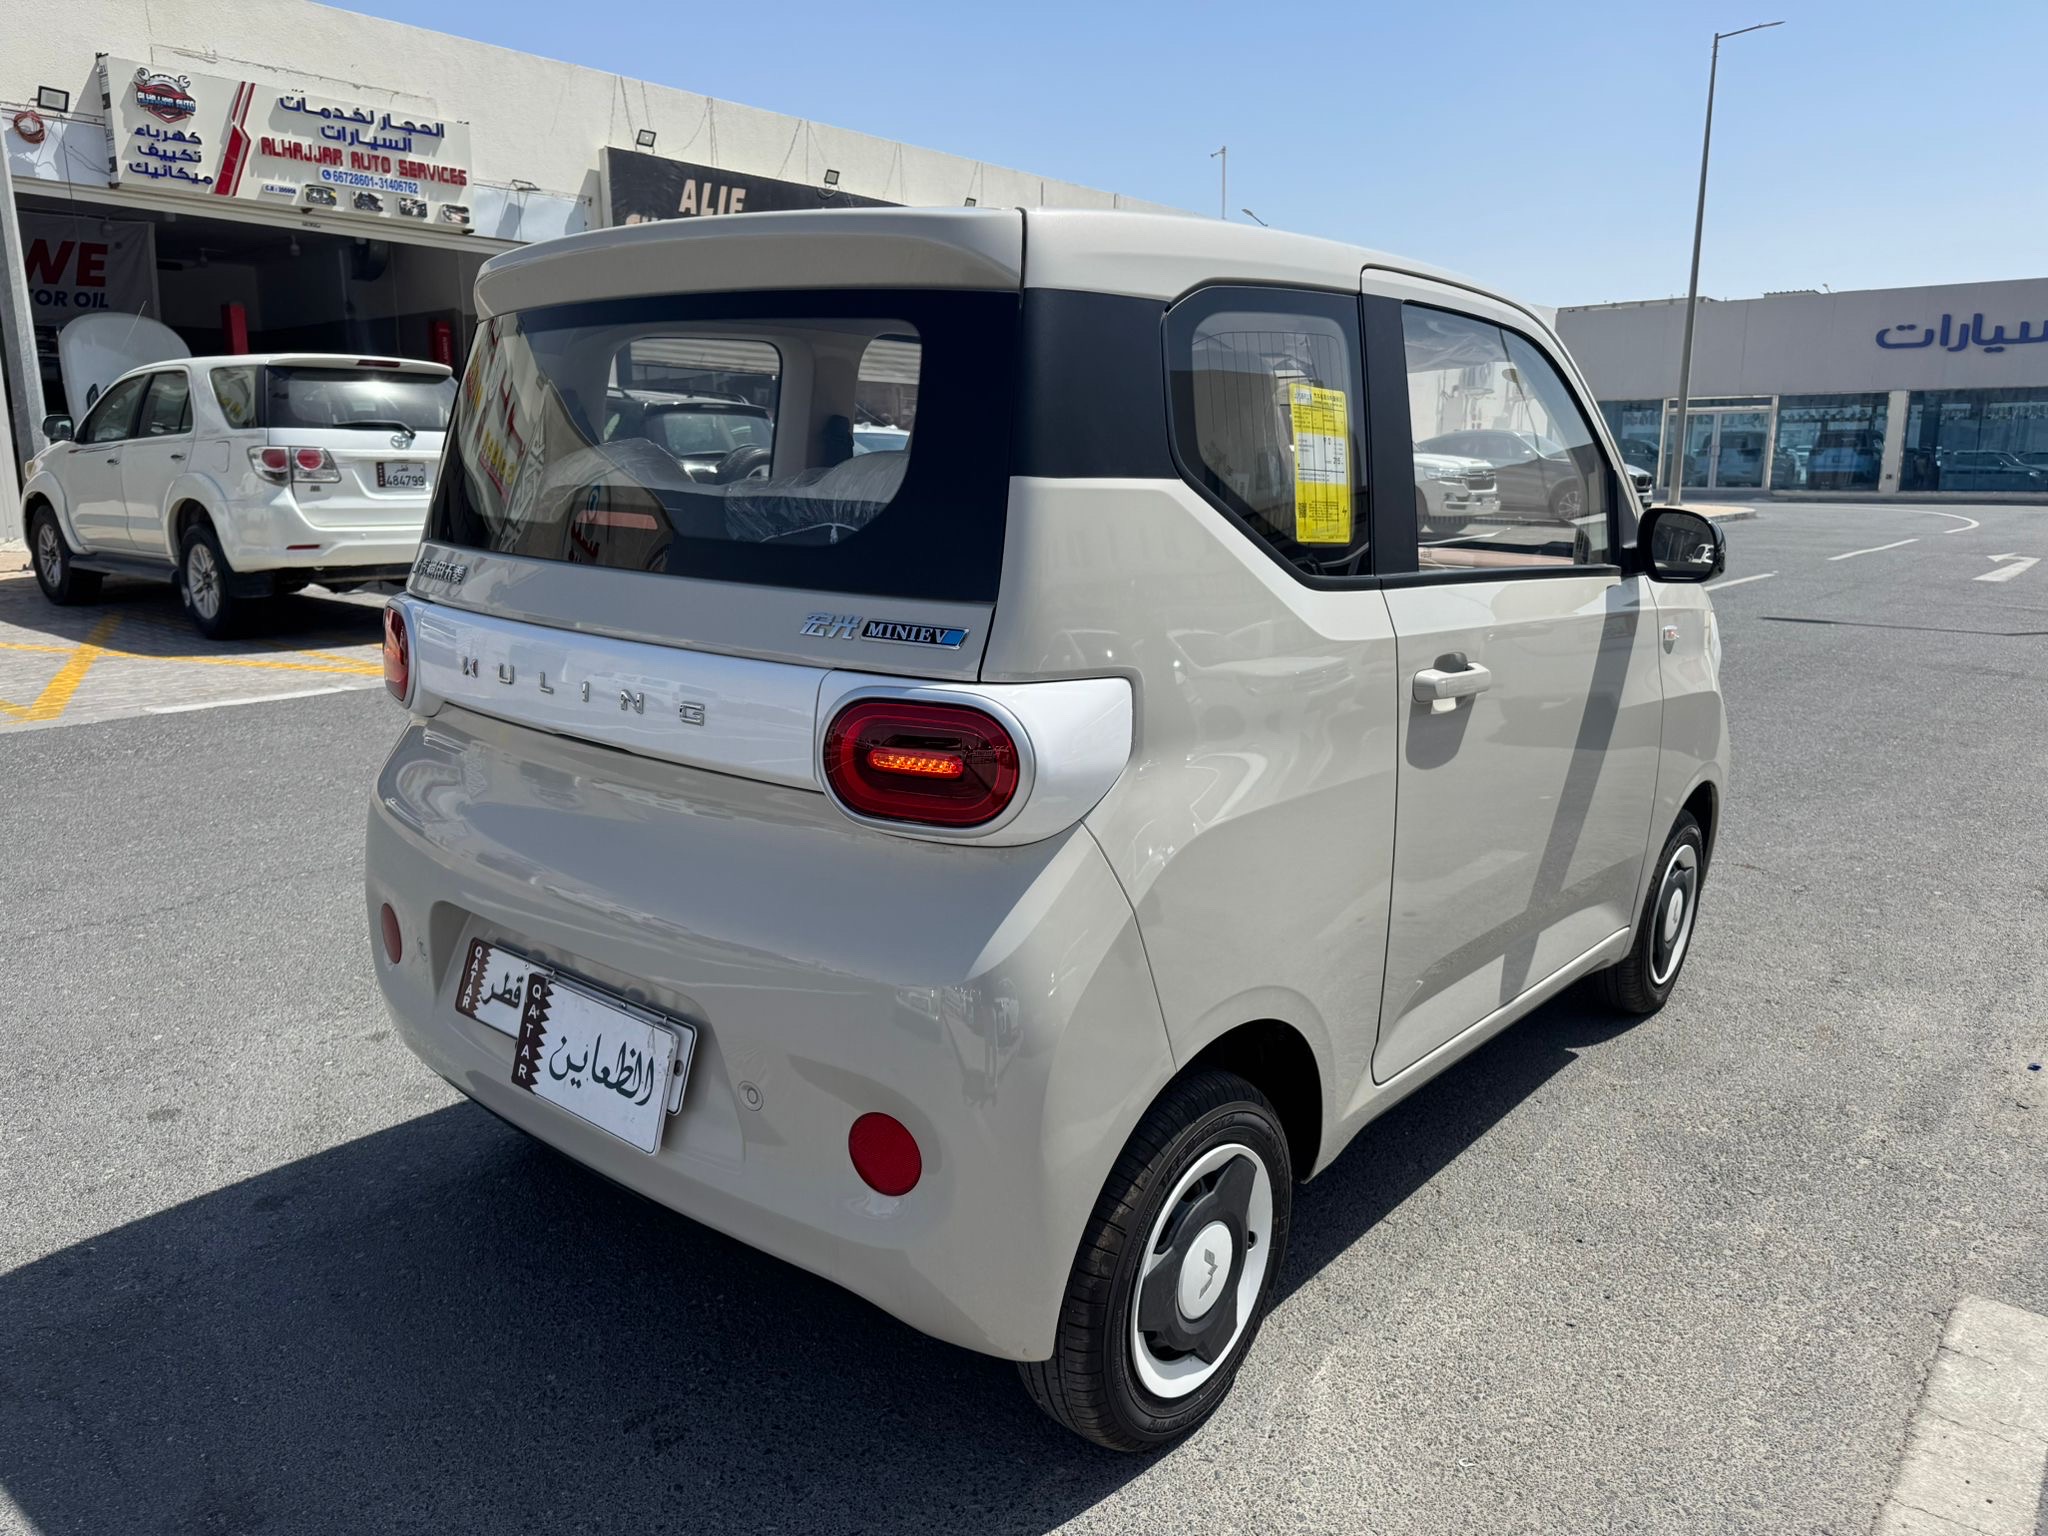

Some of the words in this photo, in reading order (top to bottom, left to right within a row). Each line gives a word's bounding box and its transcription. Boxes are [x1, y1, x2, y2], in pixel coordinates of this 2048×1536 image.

[279, 95, 375, 126] لخدمات
[134, 124, 202, 145] كهرباء
[320, 124, 412, 152] السيارات
[380, 112, 445, 139] الحجار
[137, 142, 202, 163] تكييف
[261, 136, 344, 167] ALHAJJAR
[350, 151, 392, 174] AUTO
[398, 159, 467, 187] SERVICES
[128, 161, 214, 185] ميكانيك
[29, 288, 68, 308] OR
[73, 291, 109, 308] OIL
[386, 475, 424, 487] 484799
[867, 621, 949, 645] MINIEV
[461, 945, 484, 1010] QATAR
[480, 972, 525, 1006] قطر
[517, 982, 543, 1083] QATAR
